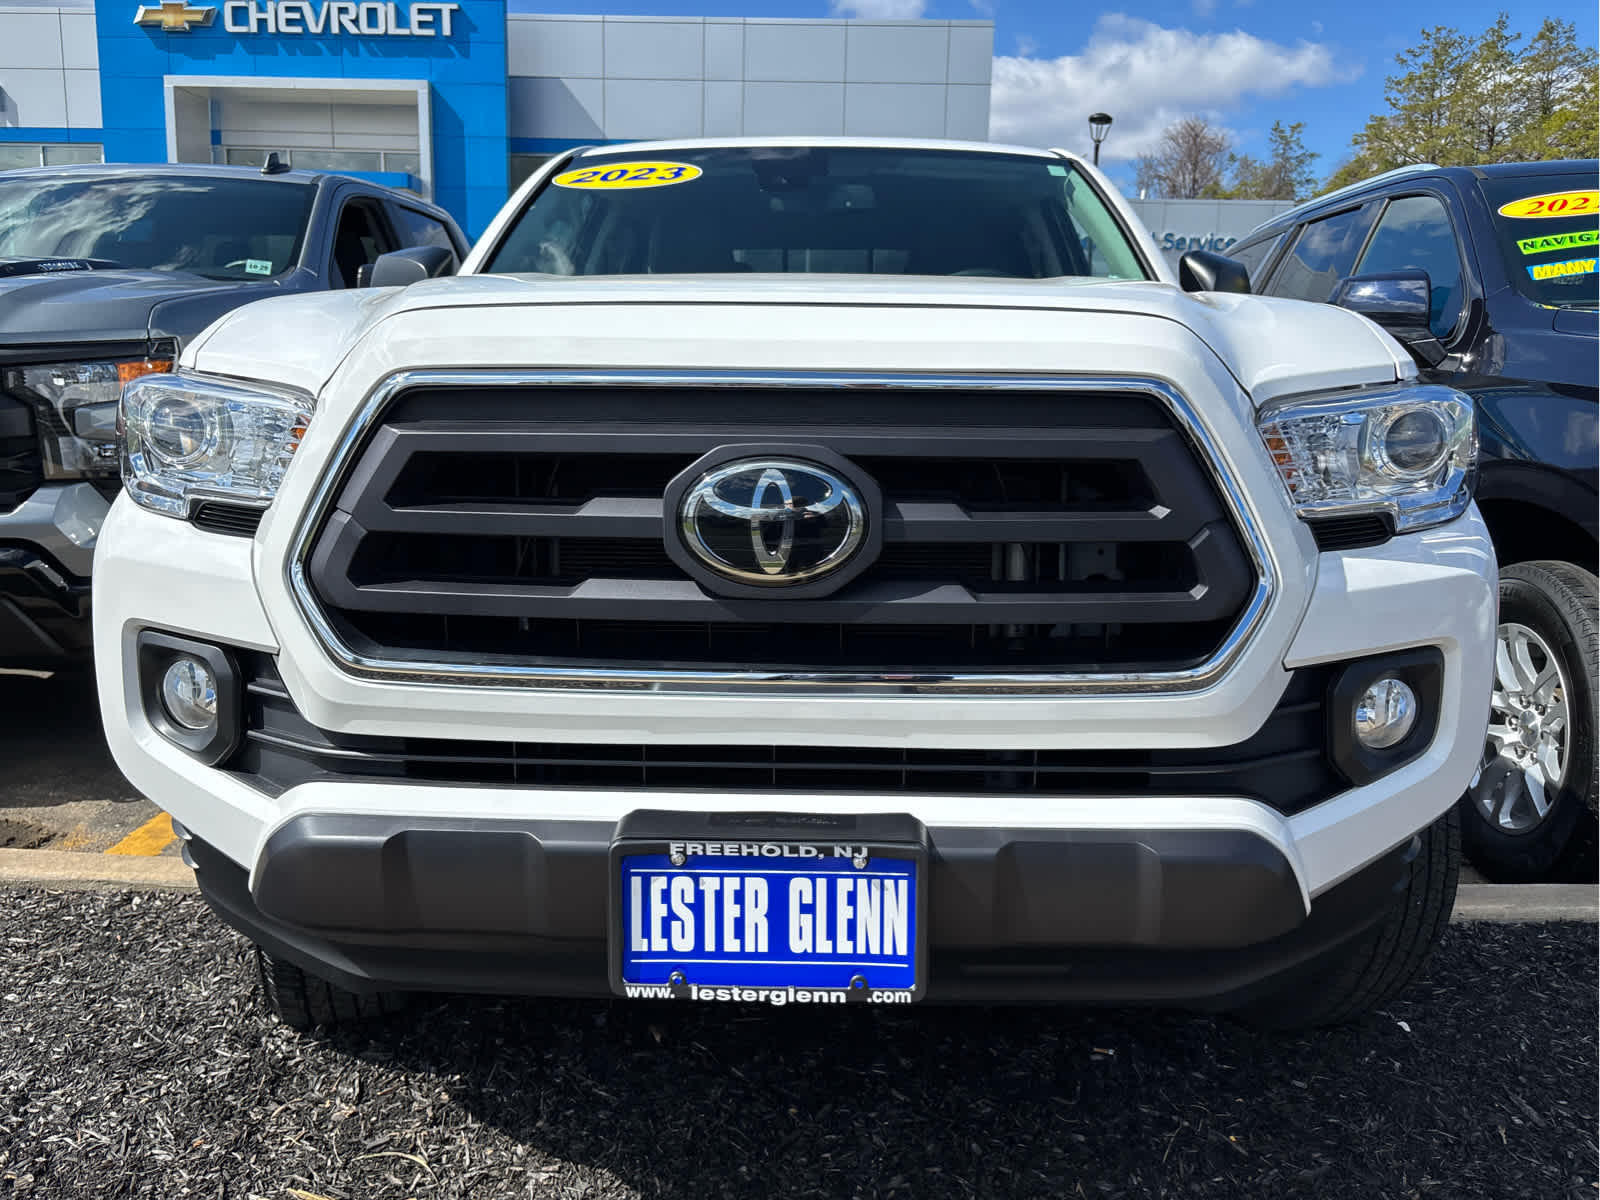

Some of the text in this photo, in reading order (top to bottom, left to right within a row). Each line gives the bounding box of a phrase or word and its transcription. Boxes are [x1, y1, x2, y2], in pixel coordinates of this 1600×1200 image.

[223, 1, 458, 36] CHEVROLET
[568, 167, 687, 184] 2023
[1525, 197, 1599, 215] 202
[1161, 232, 1237, 251] Service
[1532, 259, 1596, 280] MANY
[669, 842, 868, 860] FREEHOLD, NJ
[631, 876, 908, 956] LESTER GLENN
